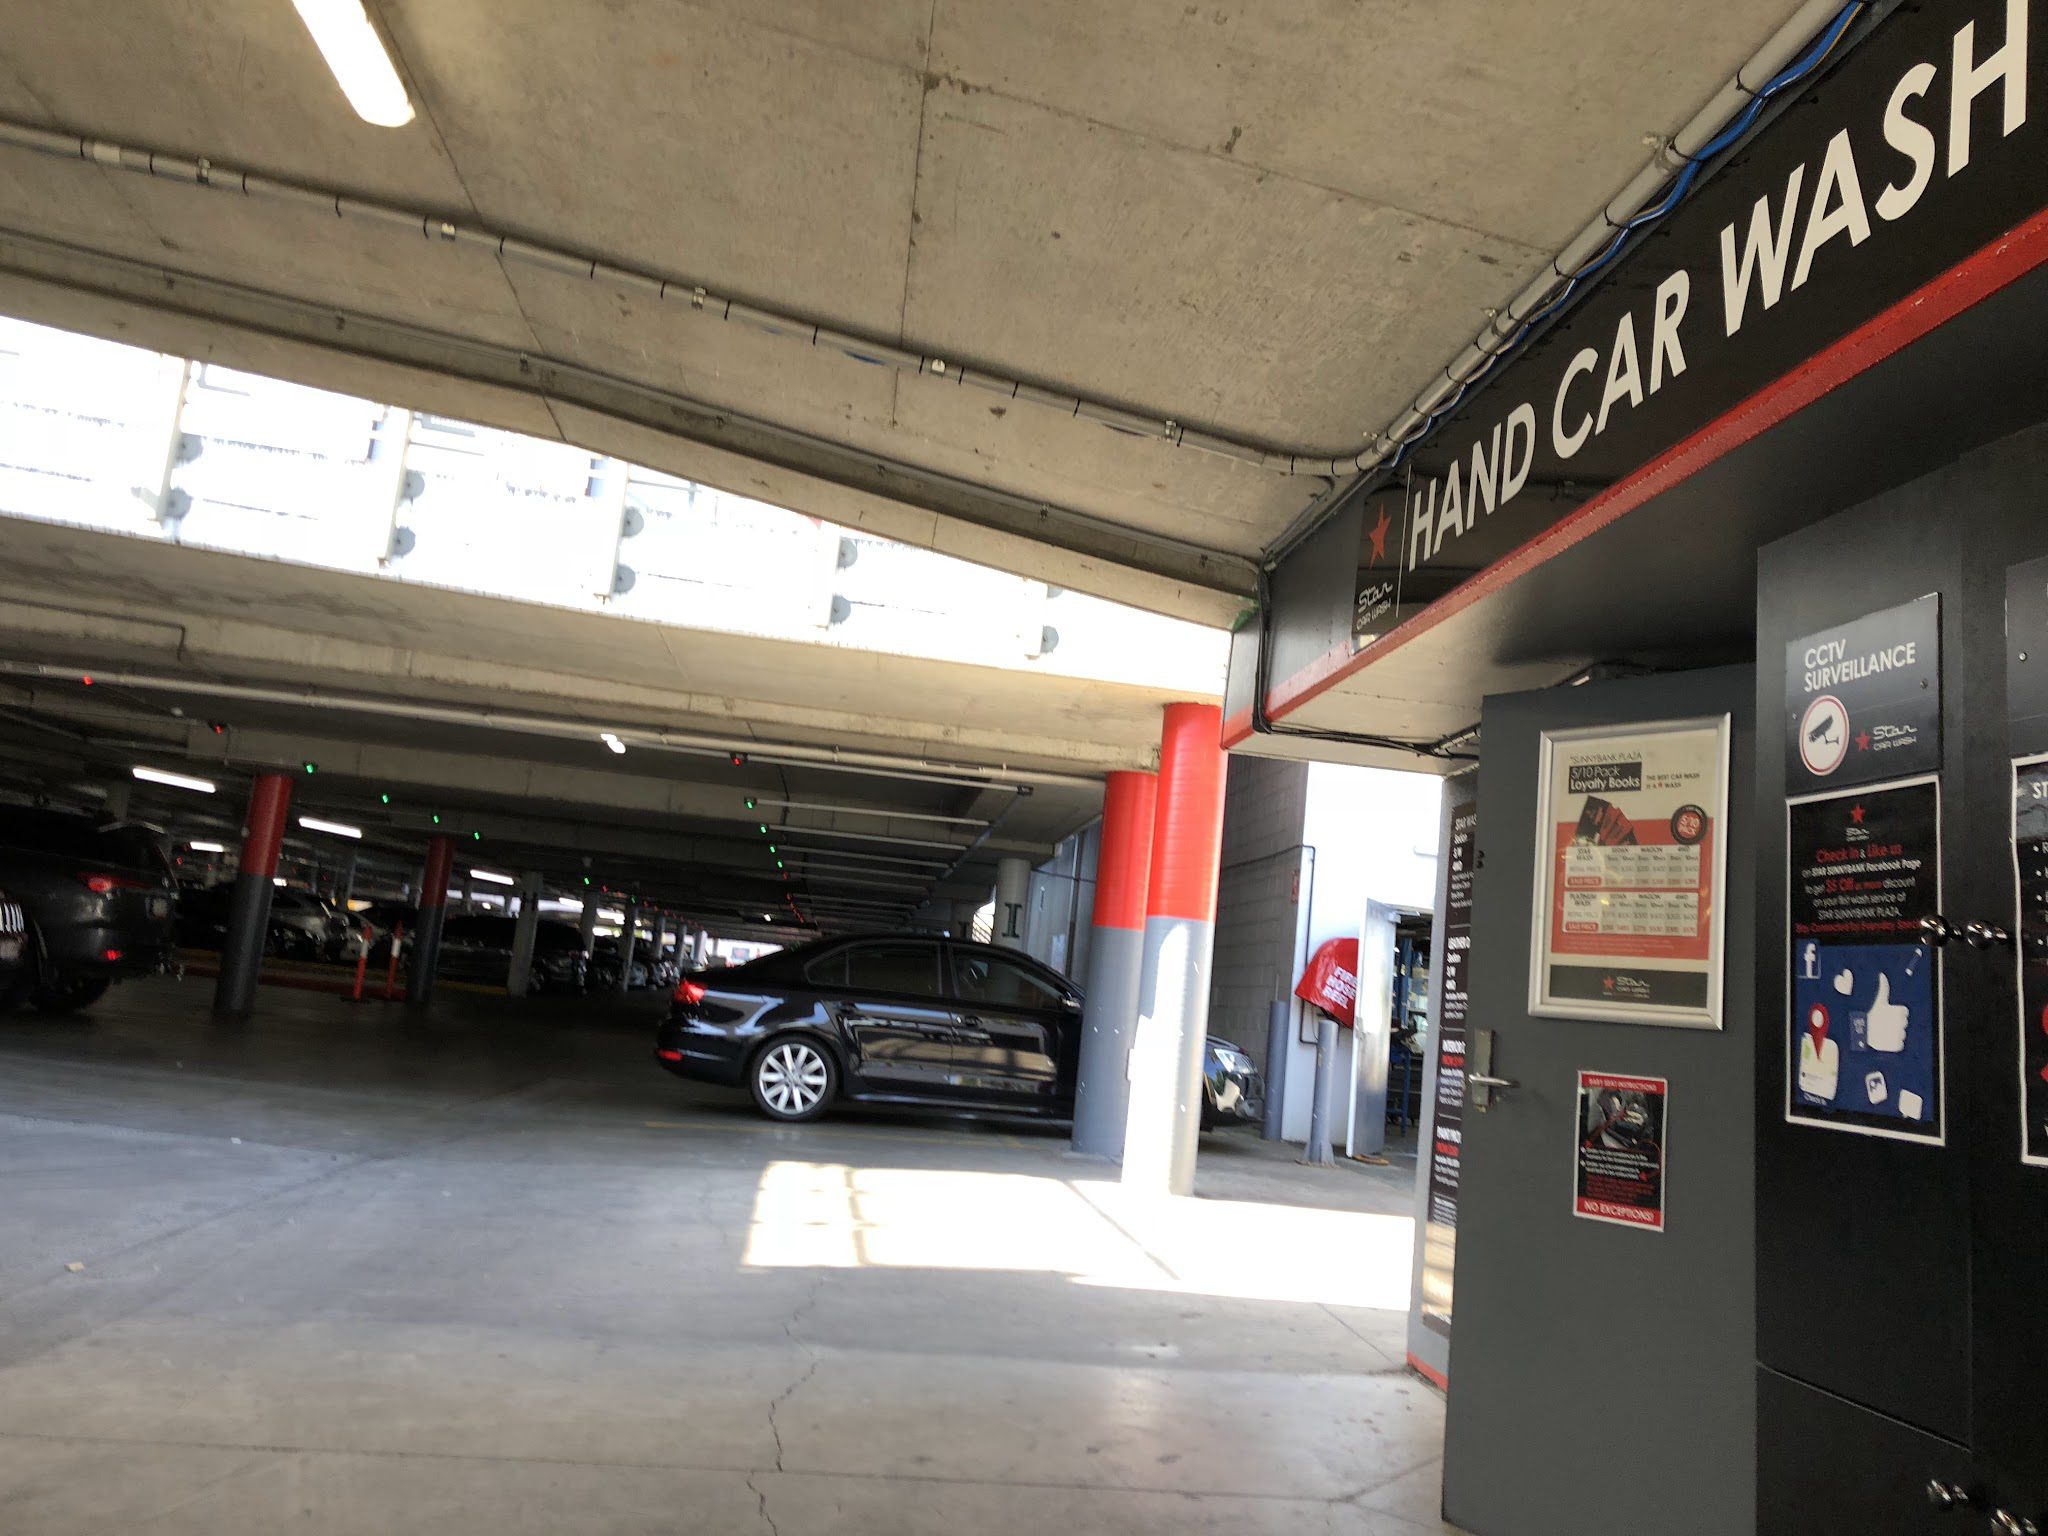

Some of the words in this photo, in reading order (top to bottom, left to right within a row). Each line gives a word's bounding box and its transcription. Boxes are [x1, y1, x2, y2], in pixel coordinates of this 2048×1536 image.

[1409, 403, 1536, 572] HAND
[1552, 270, 1690, 459] CAR
[1721, 0, 2029, 338] WASH
[1358, 581, 1393, 612] Star
[1804, 638, 1846, 669] CCTV
[1804, 642, 1916, 692] SURVEILLANCE
[1873, 724, 1918, 740] Star
[1618, 752, 1642, 762] PLAZA
[1571, 766, 1594, 778] 5/10
[1594, 766, 1620, 777] Pack
[1570, 778, 1606, 792] Loyalty
[1609, 776, 1640, 788] Books
[1816, 848, 1848, 863] Check
[1866, 844, 1888, 858] Like
[1827, 864, 1866, 876] SUNNYBANK
[1902, 859, 1922, 870] Page
[1584, 1201, 1599, 1213] NO
